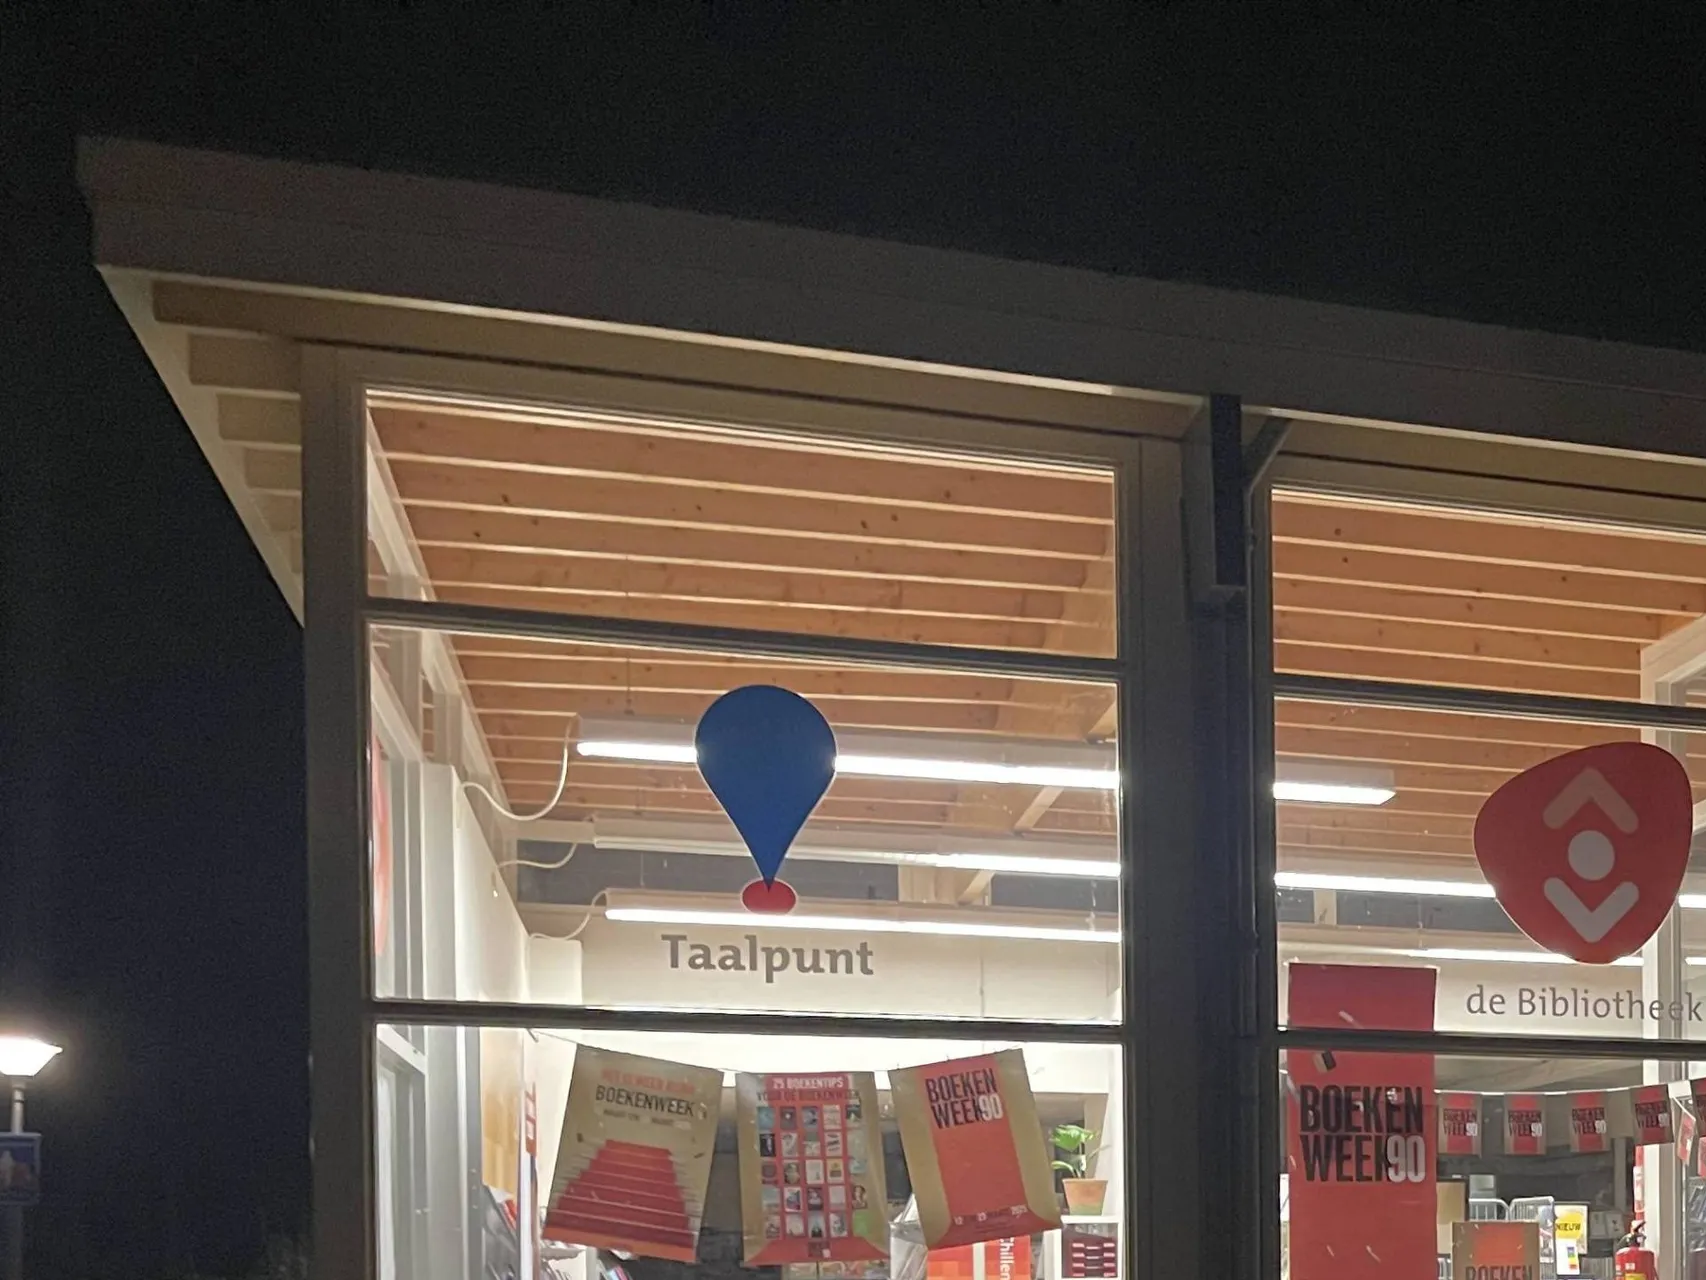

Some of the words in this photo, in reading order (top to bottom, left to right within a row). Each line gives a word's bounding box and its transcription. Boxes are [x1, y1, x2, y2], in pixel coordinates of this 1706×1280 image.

[661, 933, 875, 984] Taalpunt
[1466, 984, 1506, 1015] de
[1518, 986, 1704, 1022] Bibliotheek
[595, 1085, 695, 1117] BOEKENWEEK
[925, 1067, 998, 1102] BOEKEN
[1299, 1084, 1423, 1133] BOEKEN
[1555, 1222, 1581, 1232] NIEUW
